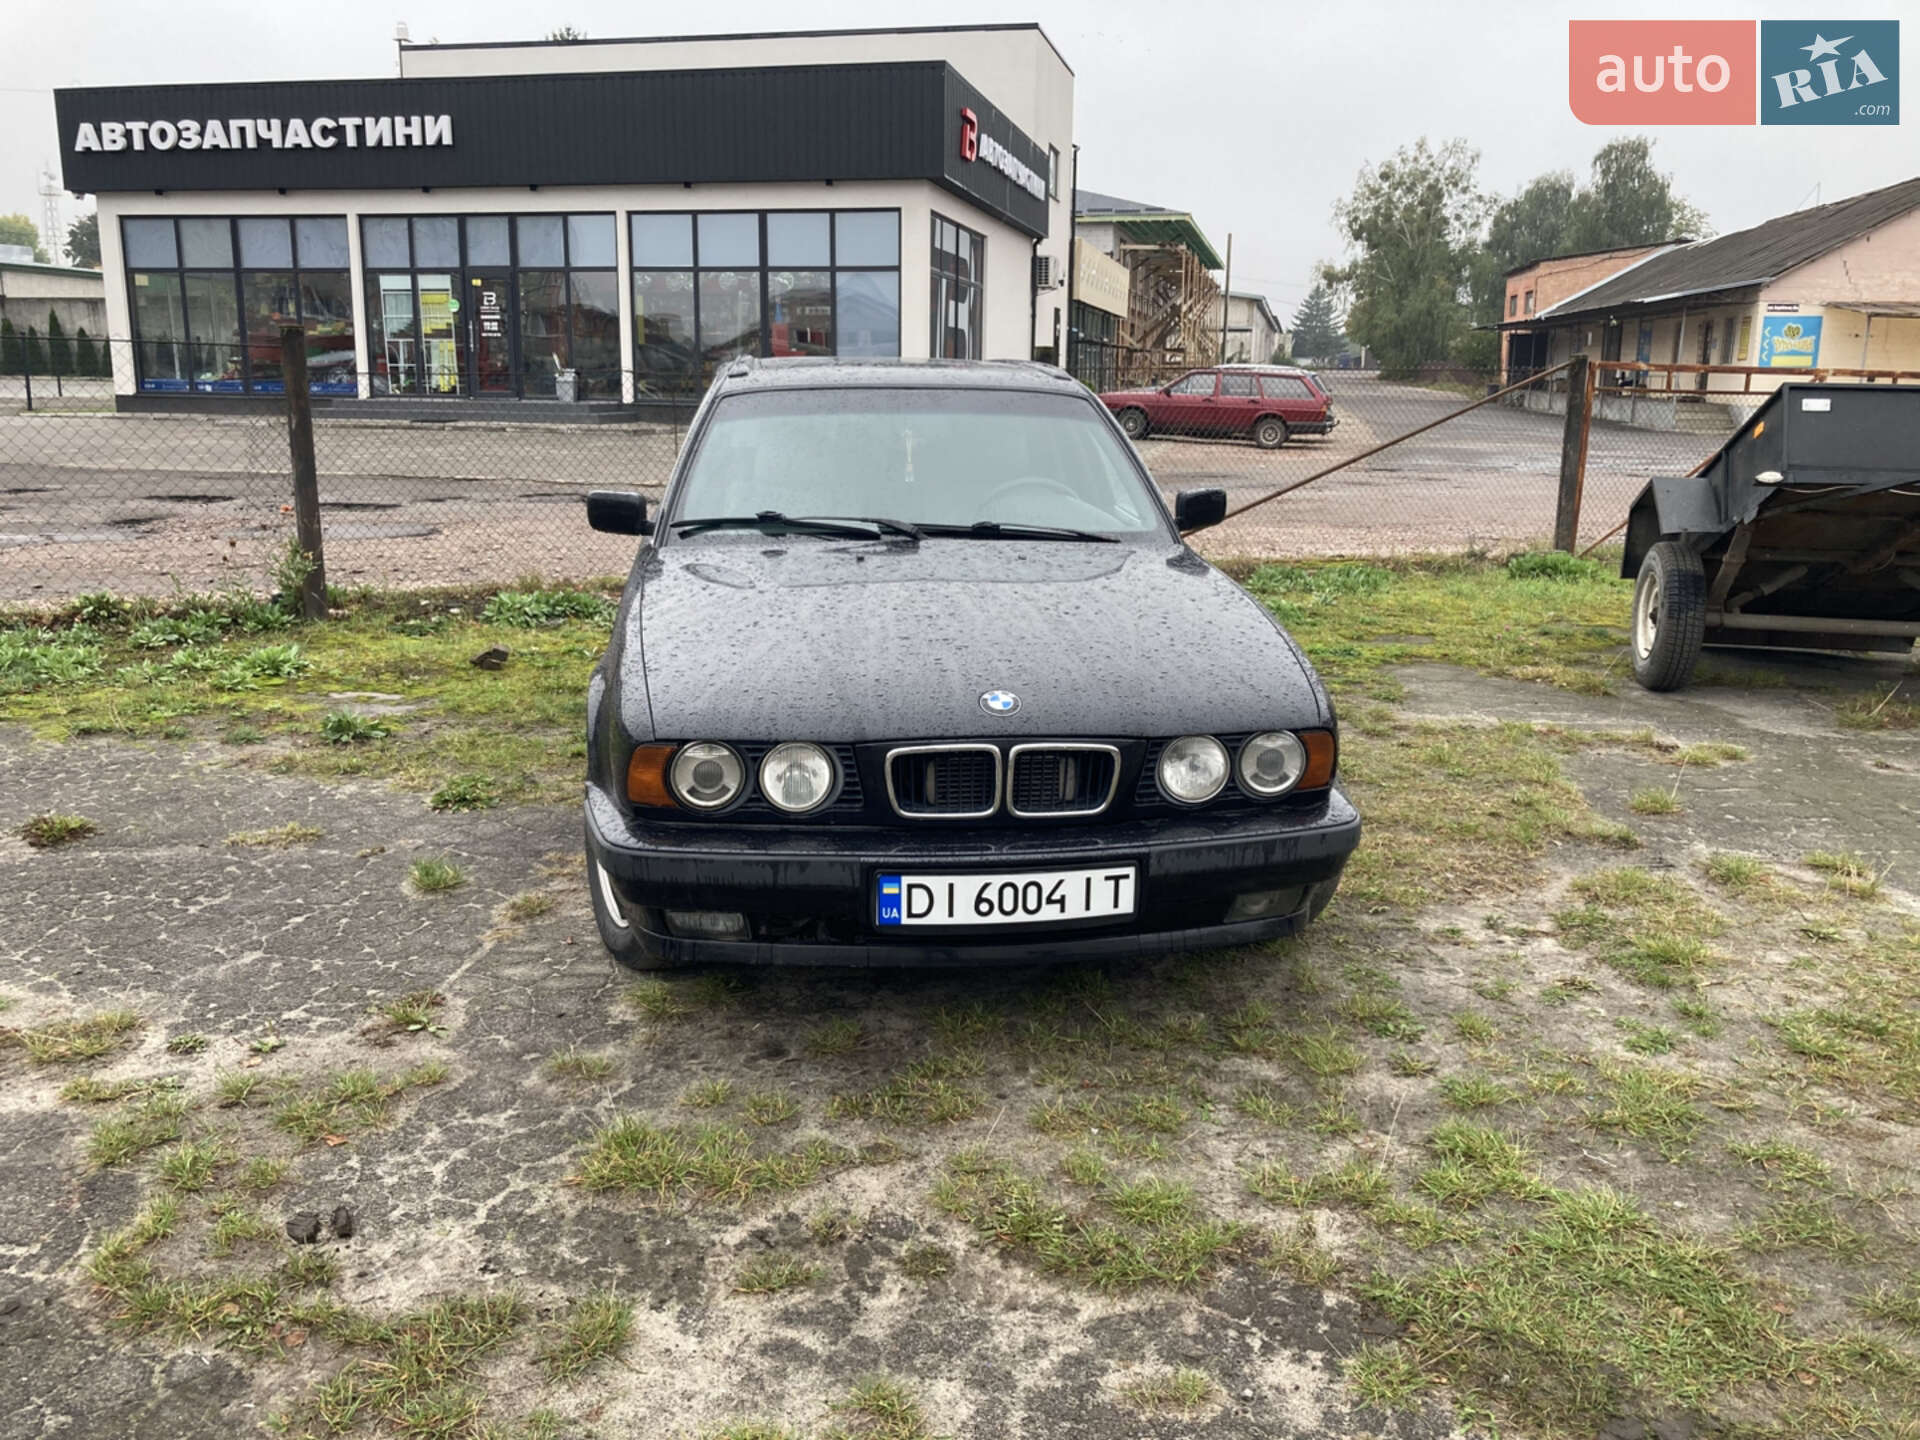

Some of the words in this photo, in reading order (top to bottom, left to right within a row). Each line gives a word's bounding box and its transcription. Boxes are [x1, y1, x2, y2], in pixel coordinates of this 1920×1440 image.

[74, 115, 454, 152] АВТОЗАПЧАСТИНИ
[882, 907, 900, 919] UA
[906, 882, 955, 919] DI
[973, 879, 1067, 918] 6004
[1084, 873, 1131, 912] IT
